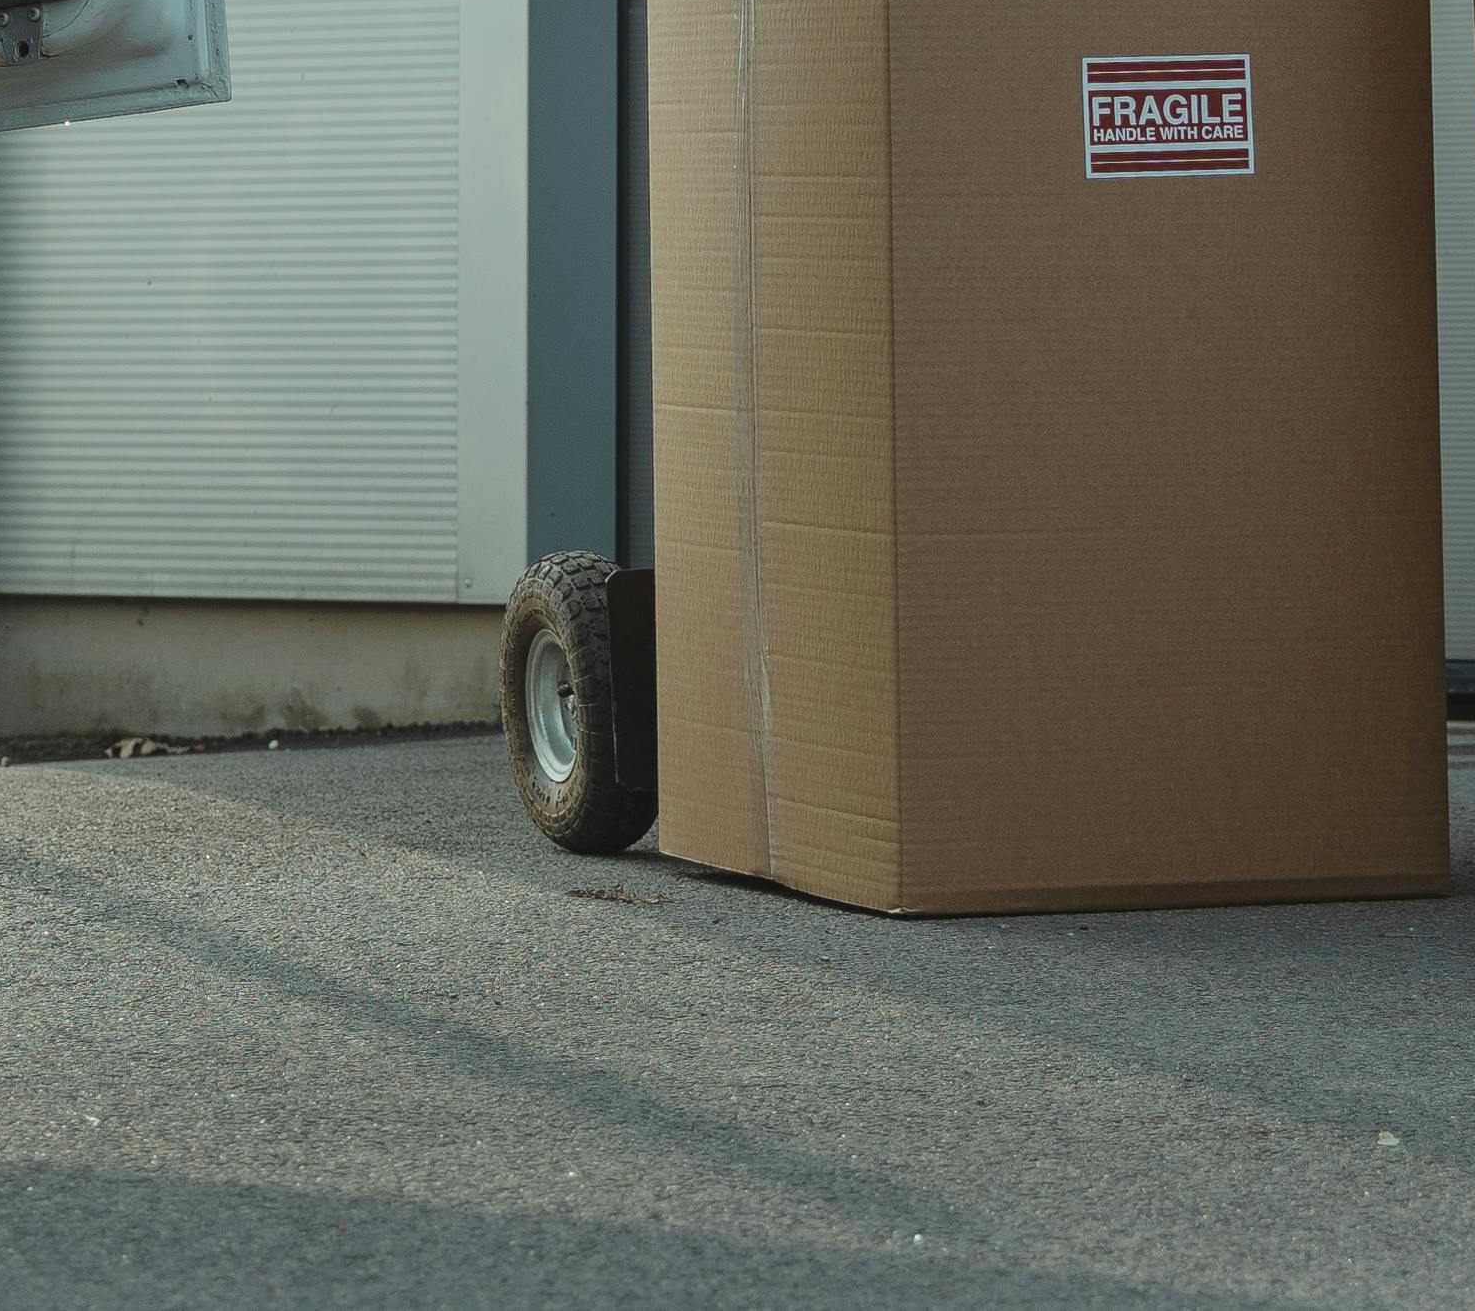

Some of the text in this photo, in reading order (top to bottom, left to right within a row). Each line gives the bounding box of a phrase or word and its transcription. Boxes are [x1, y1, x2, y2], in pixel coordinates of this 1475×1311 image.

[1091, 93, 1244, 127] FRAGILE
[1093, 125, 1244, 142] HANDLE WITH CARE
